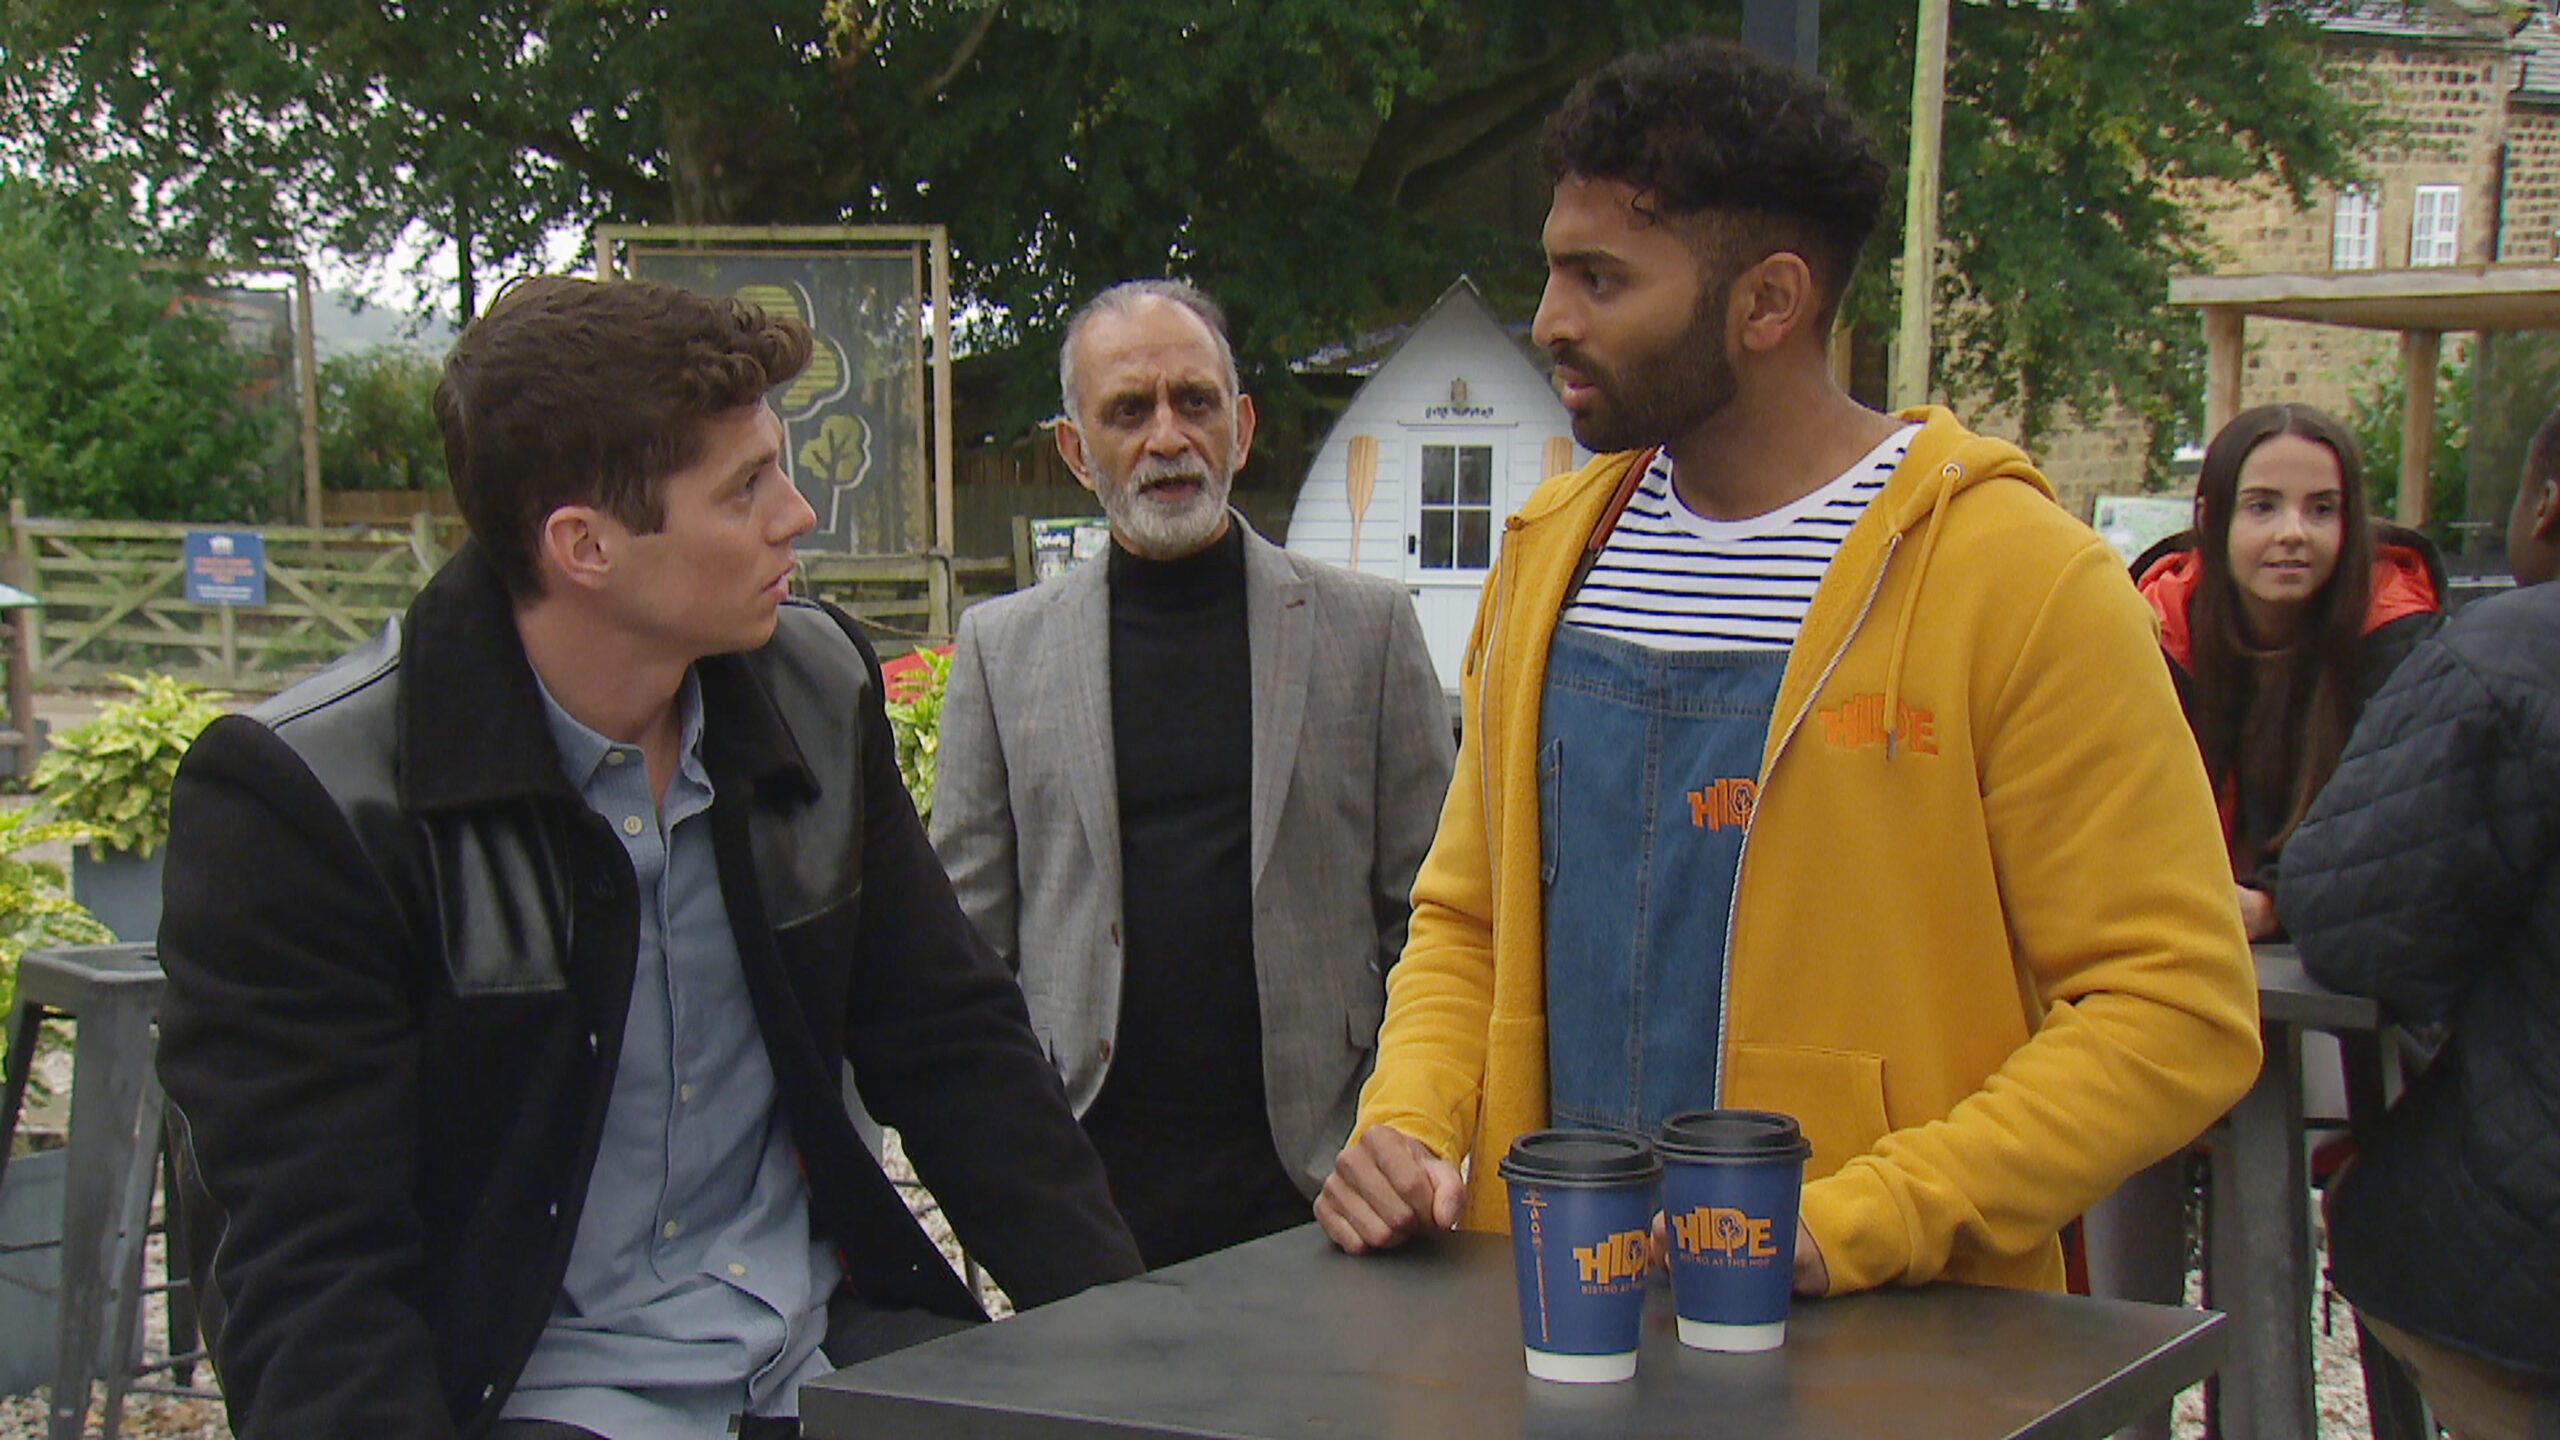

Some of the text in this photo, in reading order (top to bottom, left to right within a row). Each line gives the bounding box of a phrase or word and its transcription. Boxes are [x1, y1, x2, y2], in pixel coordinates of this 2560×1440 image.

[1818, 694, 1939, 755] HIDE
[1687, 778, 1757, 834] HID
[1573, 1230, 1650, 1284] HID
[1672, 1206, 1777, 1257] HIDE
